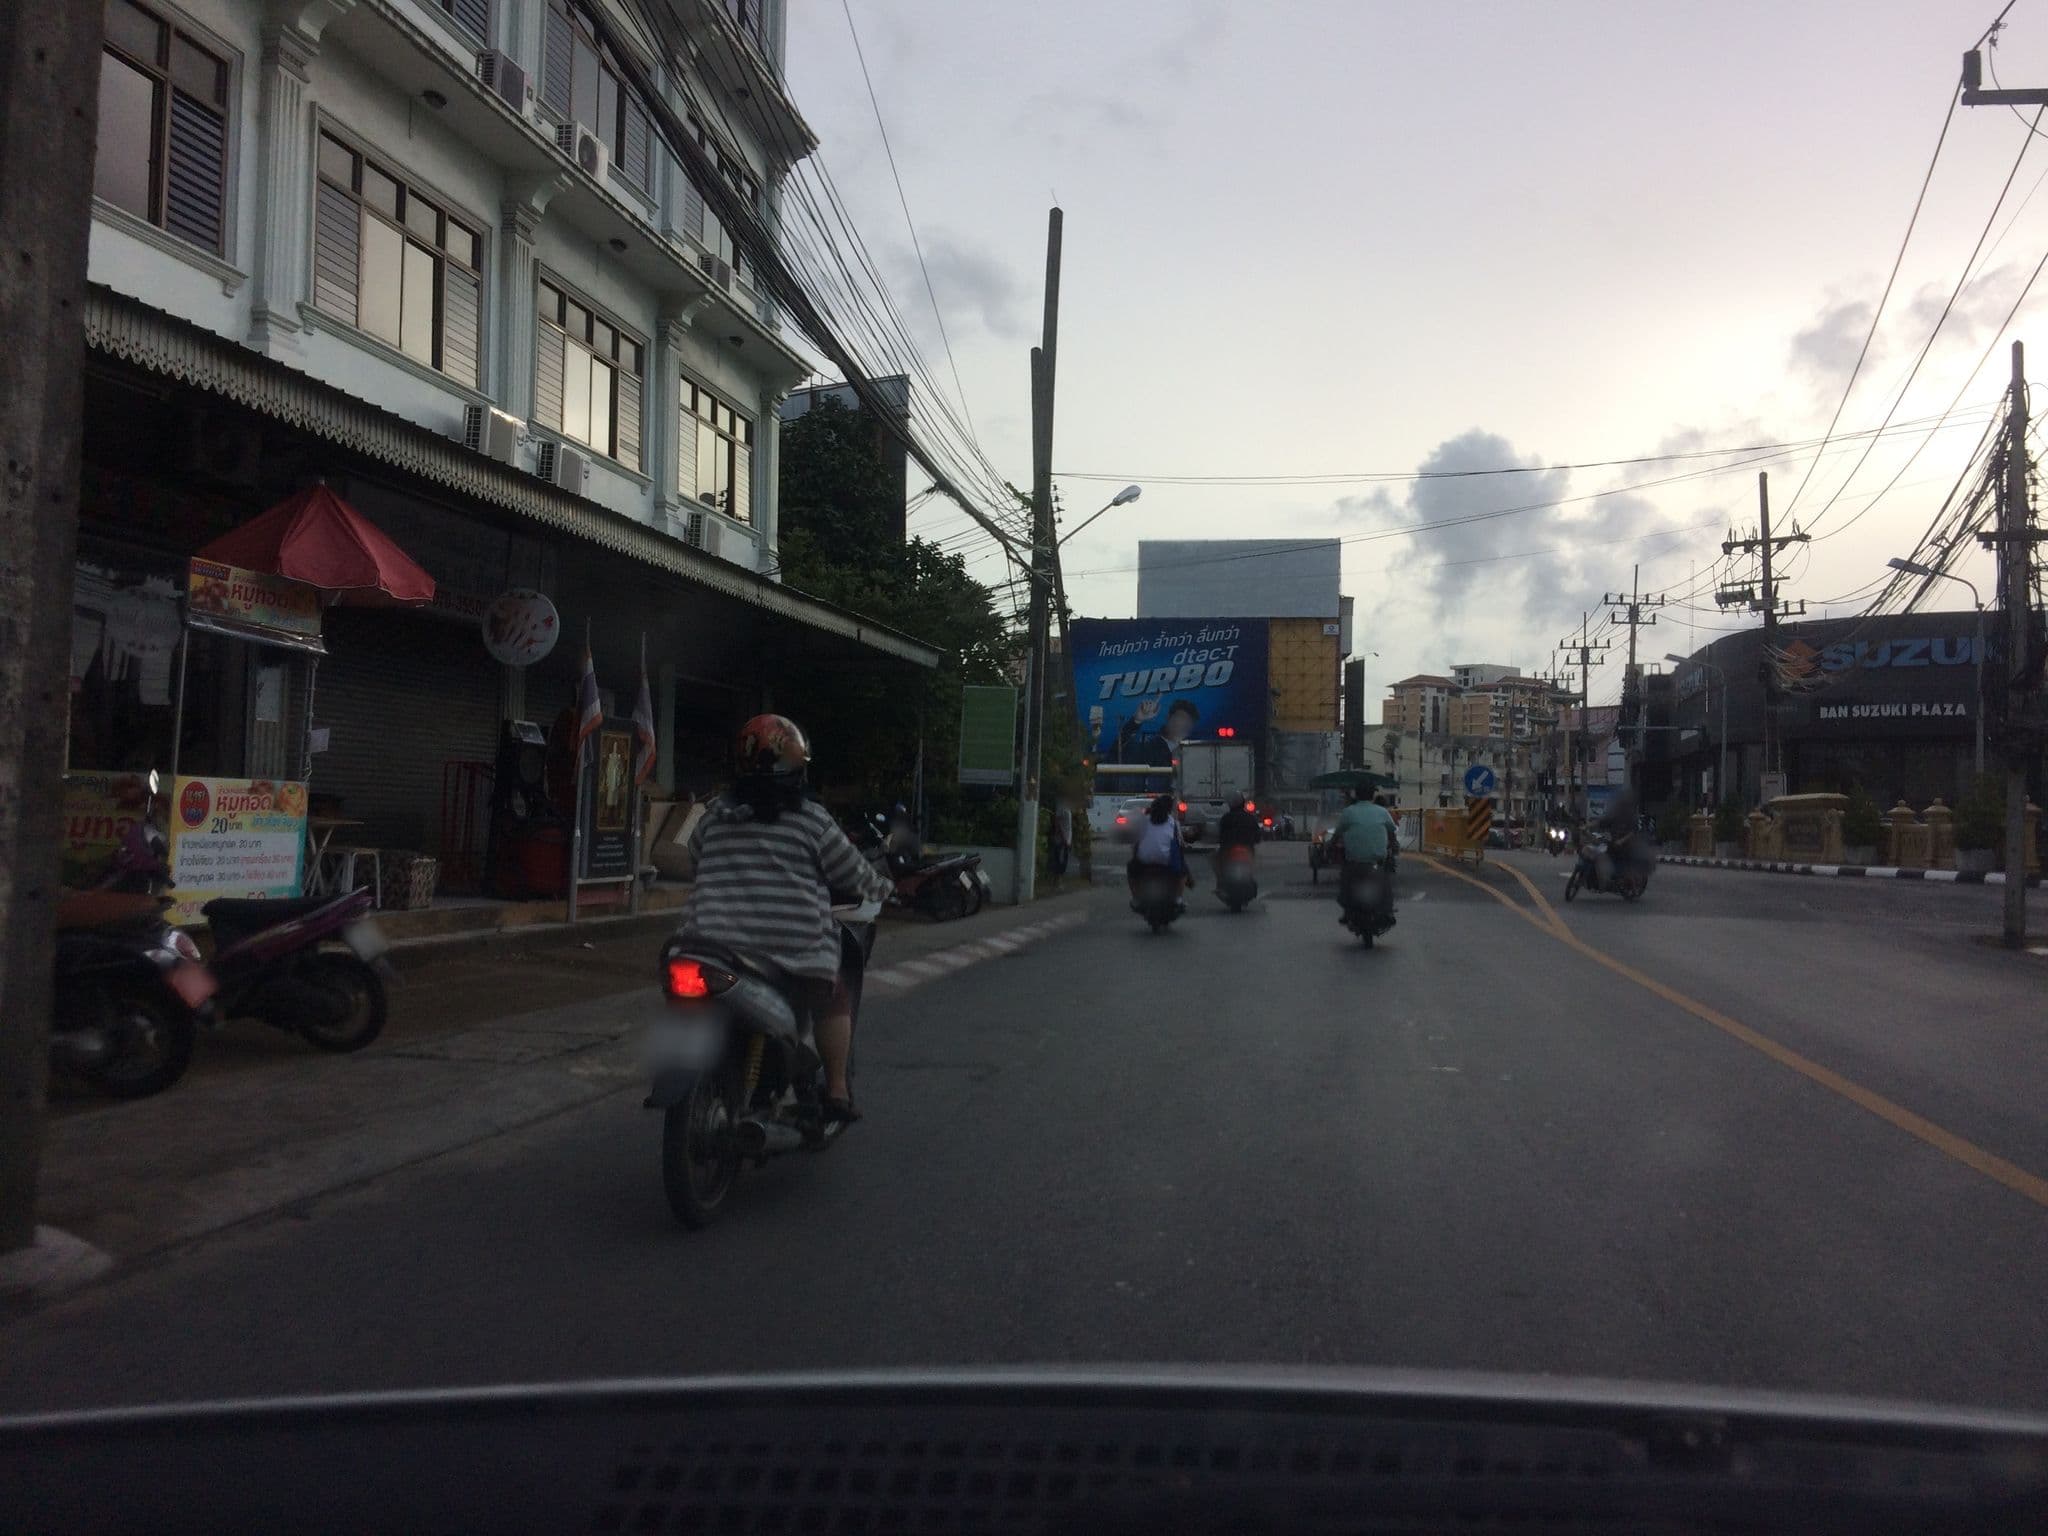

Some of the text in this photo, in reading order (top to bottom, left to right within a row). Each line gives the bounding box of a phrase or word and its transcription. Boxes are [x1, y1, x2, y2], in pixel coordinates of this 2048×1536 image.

[1098, 625, 1241, 657] ใหญ่กว่า ล้ำกว่า ลื่นกว่า
[1172, 645, 1240, 665] dtac-T
[1819, 636, 1994, 671] SUZU
[1098, 660, 1236, 700] TURBO
[1819, 703, 1967, 719] BAN SUZUKI PLAZA
[216, 796, 272, 819] หมูทอด
[210, 817, 228, 834] 20
